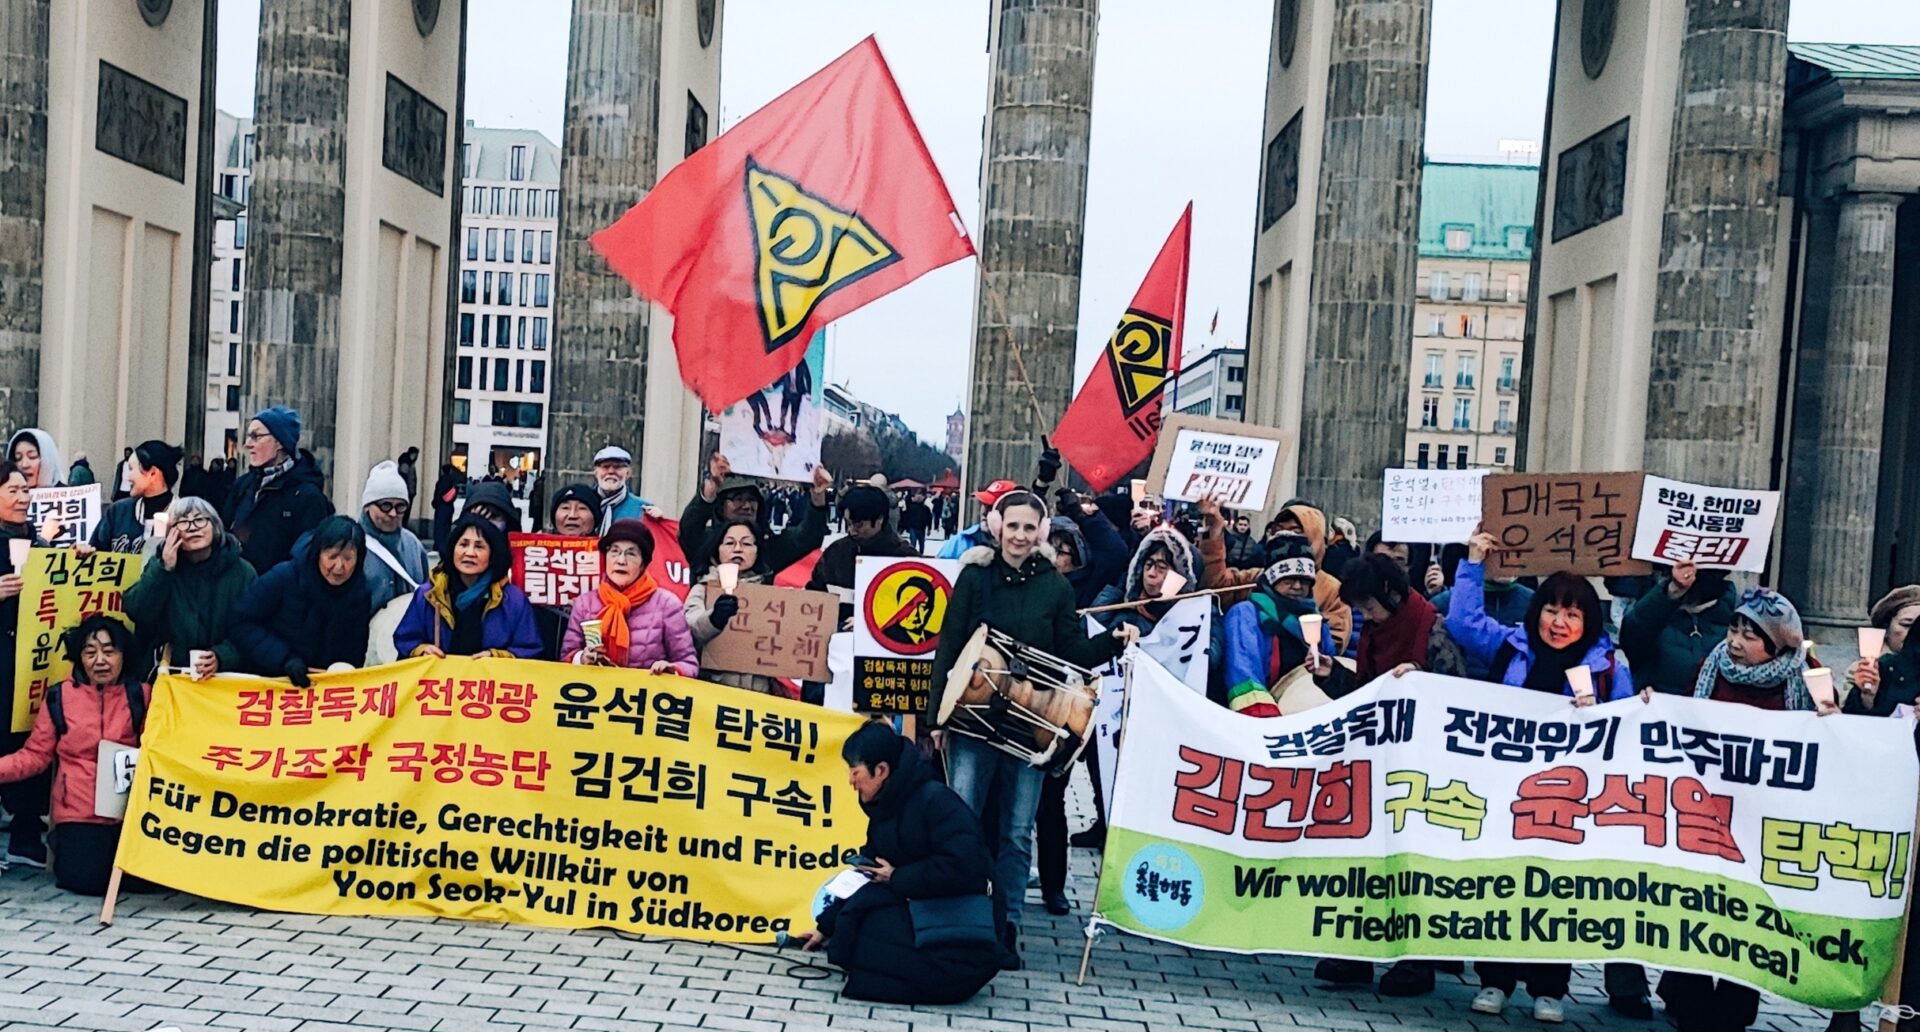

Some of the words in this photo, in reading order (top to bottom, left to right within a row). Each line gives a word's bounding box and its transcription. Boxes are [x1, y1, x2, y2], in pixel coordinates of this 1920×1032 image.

[1502, 482, 1627, 522] 매국노
[1658, 487, 1698, 511] 한일,
[1703, 495, 1761, 516] 한미일
[1667, 509, 1745, 533] 군사동맹
[44, 552, 126, 587] 김건희
[524, 546, 600, 575] 윤석열
[1494, 521, 1622, 568] 윤석열
[754, 635, 822, 678] 탄핵
[864, 660, 907, 674] 검찰독재
[236, 681, 398, 727] 검찰독재
[416, 677, 538, 724] 전쟁광
[554, 682, 694, 742] 윤석열
[715, 704, 819, 764] 탄핵!
[870, 693, 909, 710] 윤석열
[1263, 698, 1416, 759] 검찰독재
[1444, 706, 1621, 763] 전쟁위기
[1640, 721, 1819, 791] 민주파괴
[201, 742, 373, 781] 주가조작
[388, 742, 551, 792] 국정농단
[570, 751, 707, 810] 김건희
[726, 772, 833, 828] 구속!
[149, 776, 202, 814] Für
[210, 790, 427, 835] Demokratie,
[438, 803, 668, 854] Gerechtigkeit
[678, 835, 743, 862] und
[1172, 745, 1372, 842] 김건희
[1385, 770, 1487, 840] 구속
[1761, 816, 1911, 899] 탄핵!
[140, 811, 246, 857] Gegen
[257, 835, 311, 864] die
[321, 838, 479, 871] politische
[490, 846, 617, 887] Willkür
[627, 869, 688, 895] von
[332, 870, 415, 901] Yoon
[427, 873, 576, 916] Seok-Yul
[587, 895, 618, 921] in
[629, 896, 791, 933] Südkorea
[1234, 865, 1291, 898] Wir
[1297, 867, 1395, 900] wollen
[1399, 869, 1516, 901] unsere
[1525, 867, 1748, 922] Demokratie
[1755, 903, 1869, 972] zuck,
[1313, 905, 1420, 941] Frieden
[1428, 910, 1511, 941] statt
[1520, 908, 1624, 948] Krieg
[1635, 911, 1668, 948] in
[1689, 919, 1800, 985] Korea!
